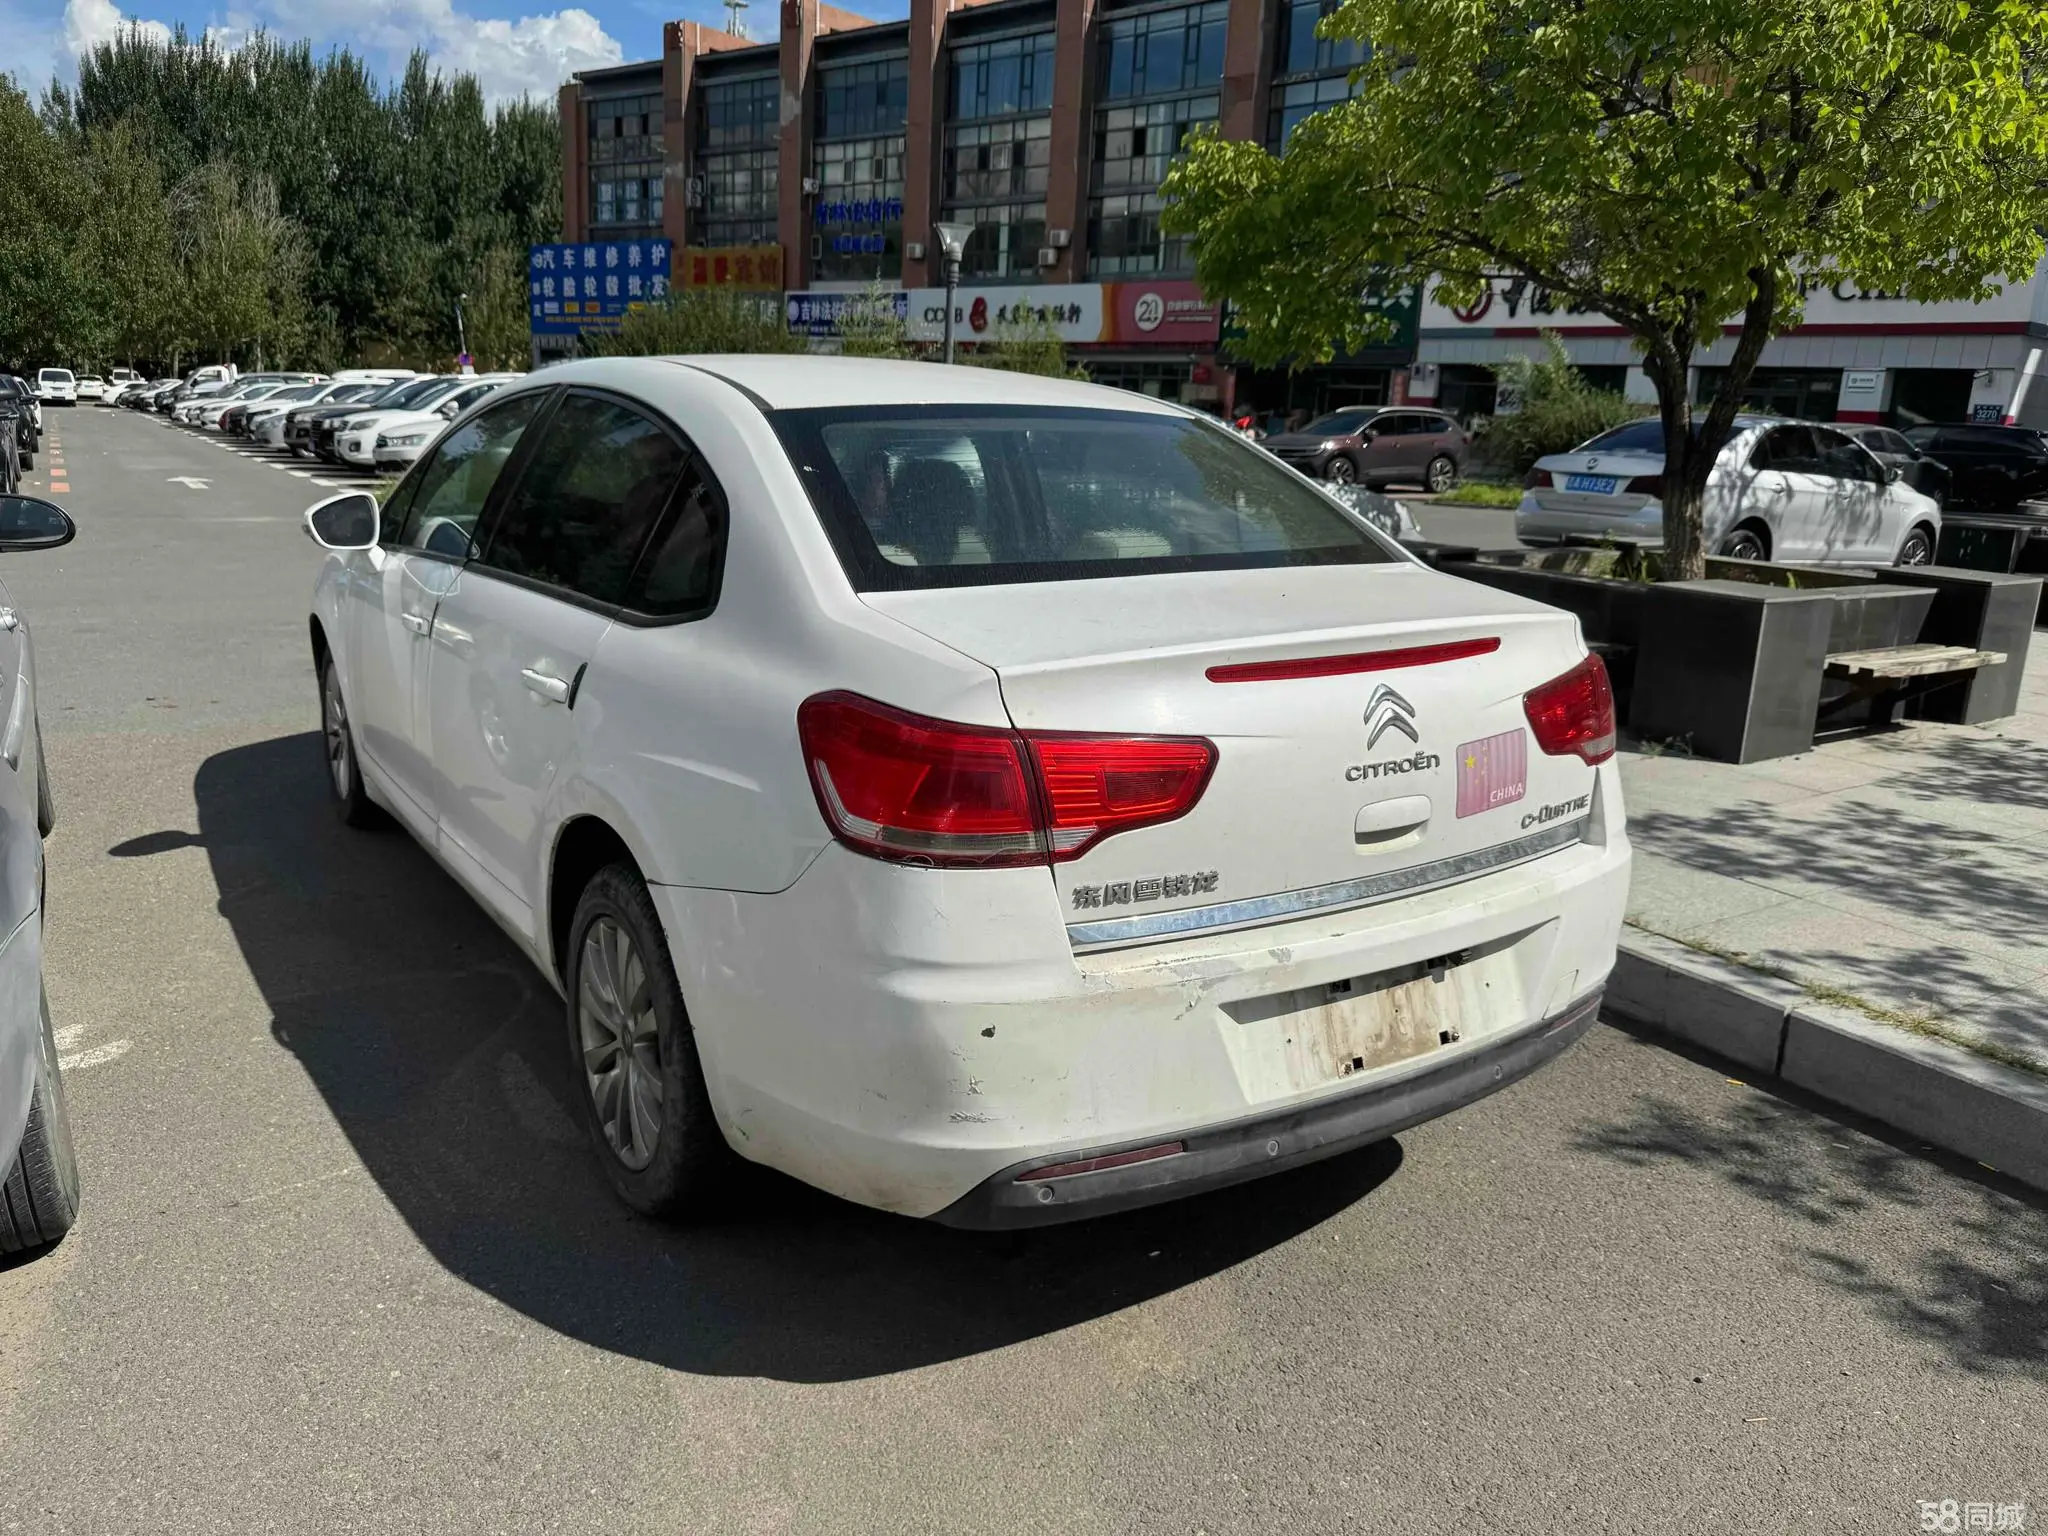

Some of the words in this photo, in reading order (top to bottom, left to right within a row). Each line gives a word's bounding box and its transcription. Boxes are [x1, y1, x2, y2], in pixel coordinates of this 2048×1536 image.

[1489, 783, 1525, 803] CHINA
[1071, 870, 1220, 910] 东风雪铁龙
